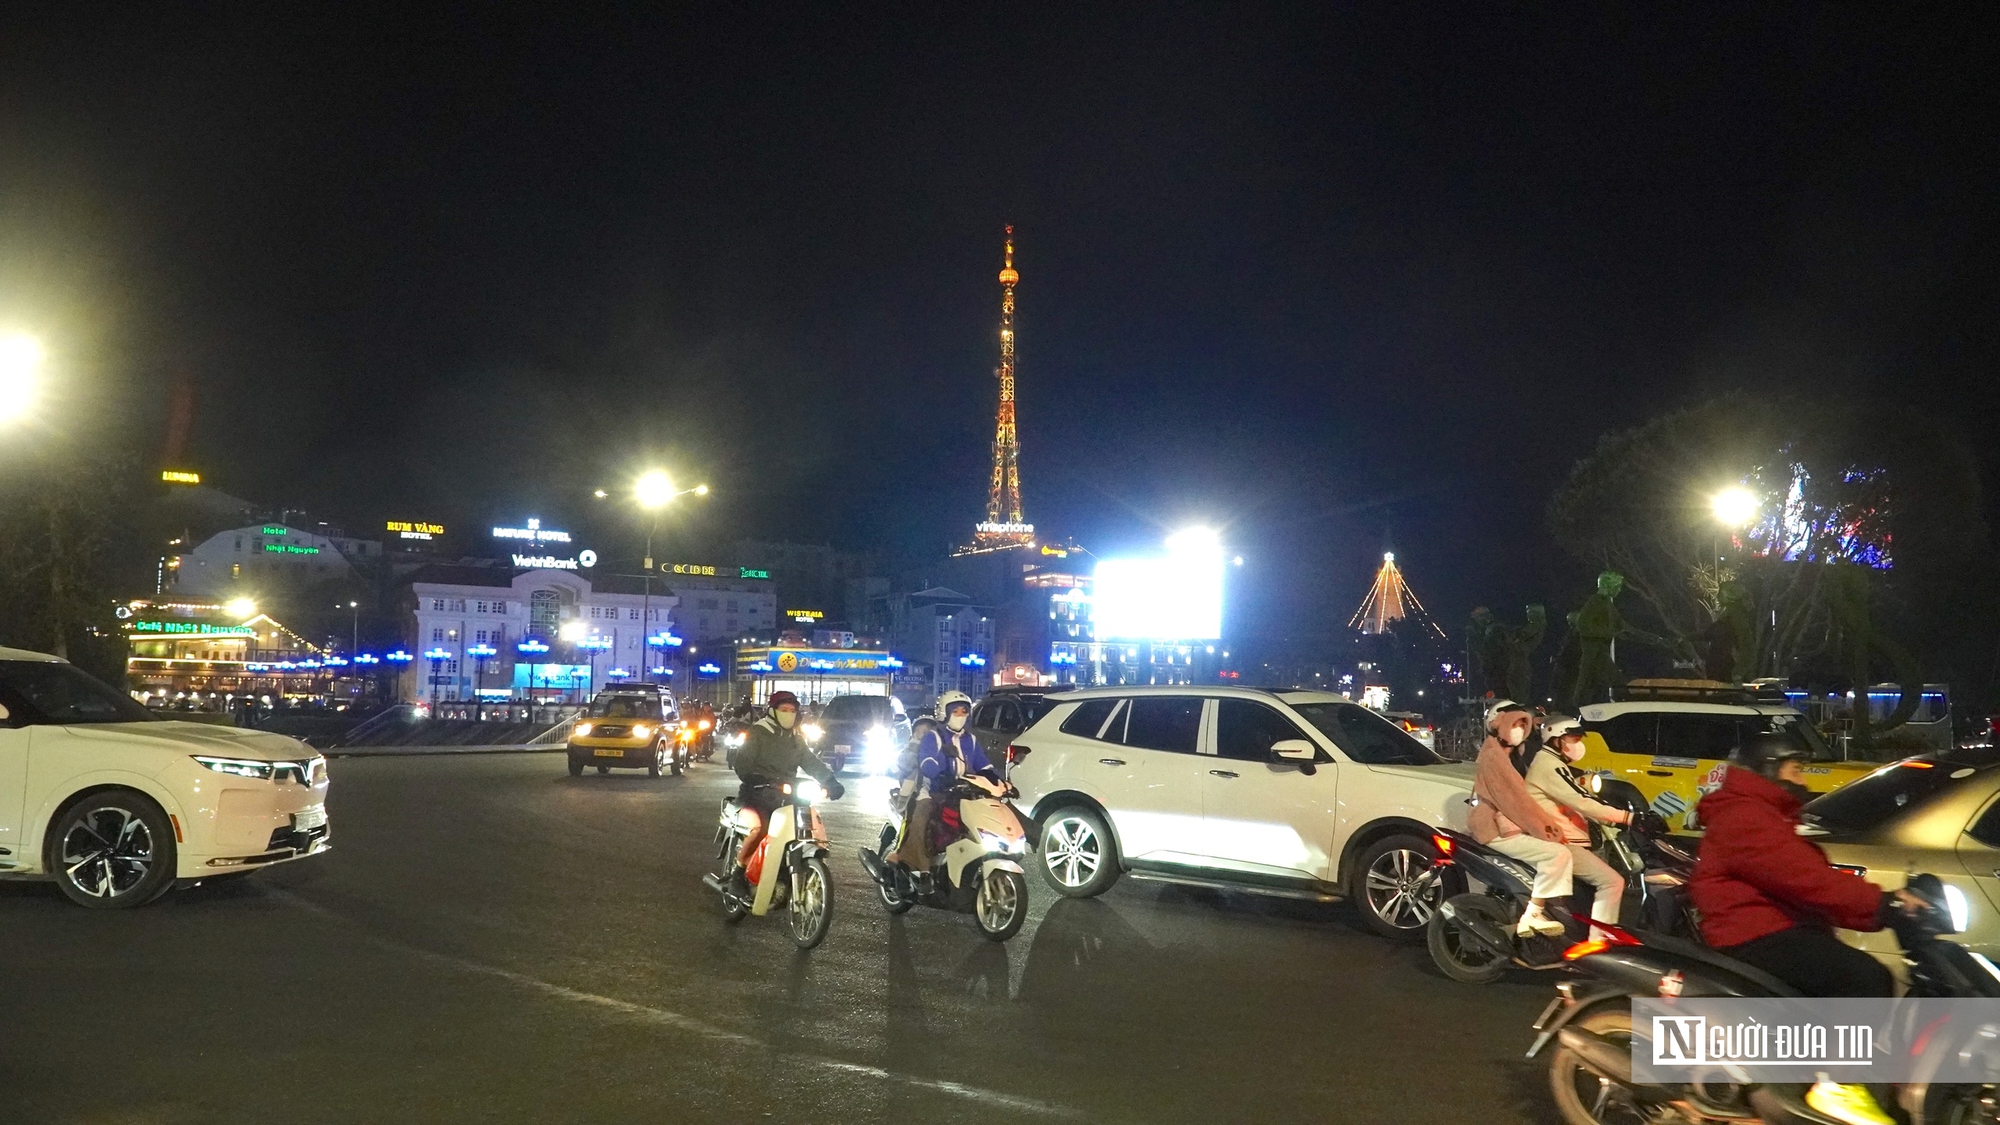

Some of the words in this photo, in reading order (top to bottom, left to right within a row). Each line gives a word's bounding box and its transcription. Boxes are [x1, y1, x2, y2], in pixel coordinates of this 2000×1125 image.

[263, 527, 287, 535] Hotel
[386, 521, 412, 532] RUM
[414, 522, 444, 534] VÀNG
[975, 521, 1034, 532] vinaphone
[400, 531, 433, 540] HOTEL
[537, 530, 571, 542] HOTEL
[786, 610, 824, 618] WISTERIA
